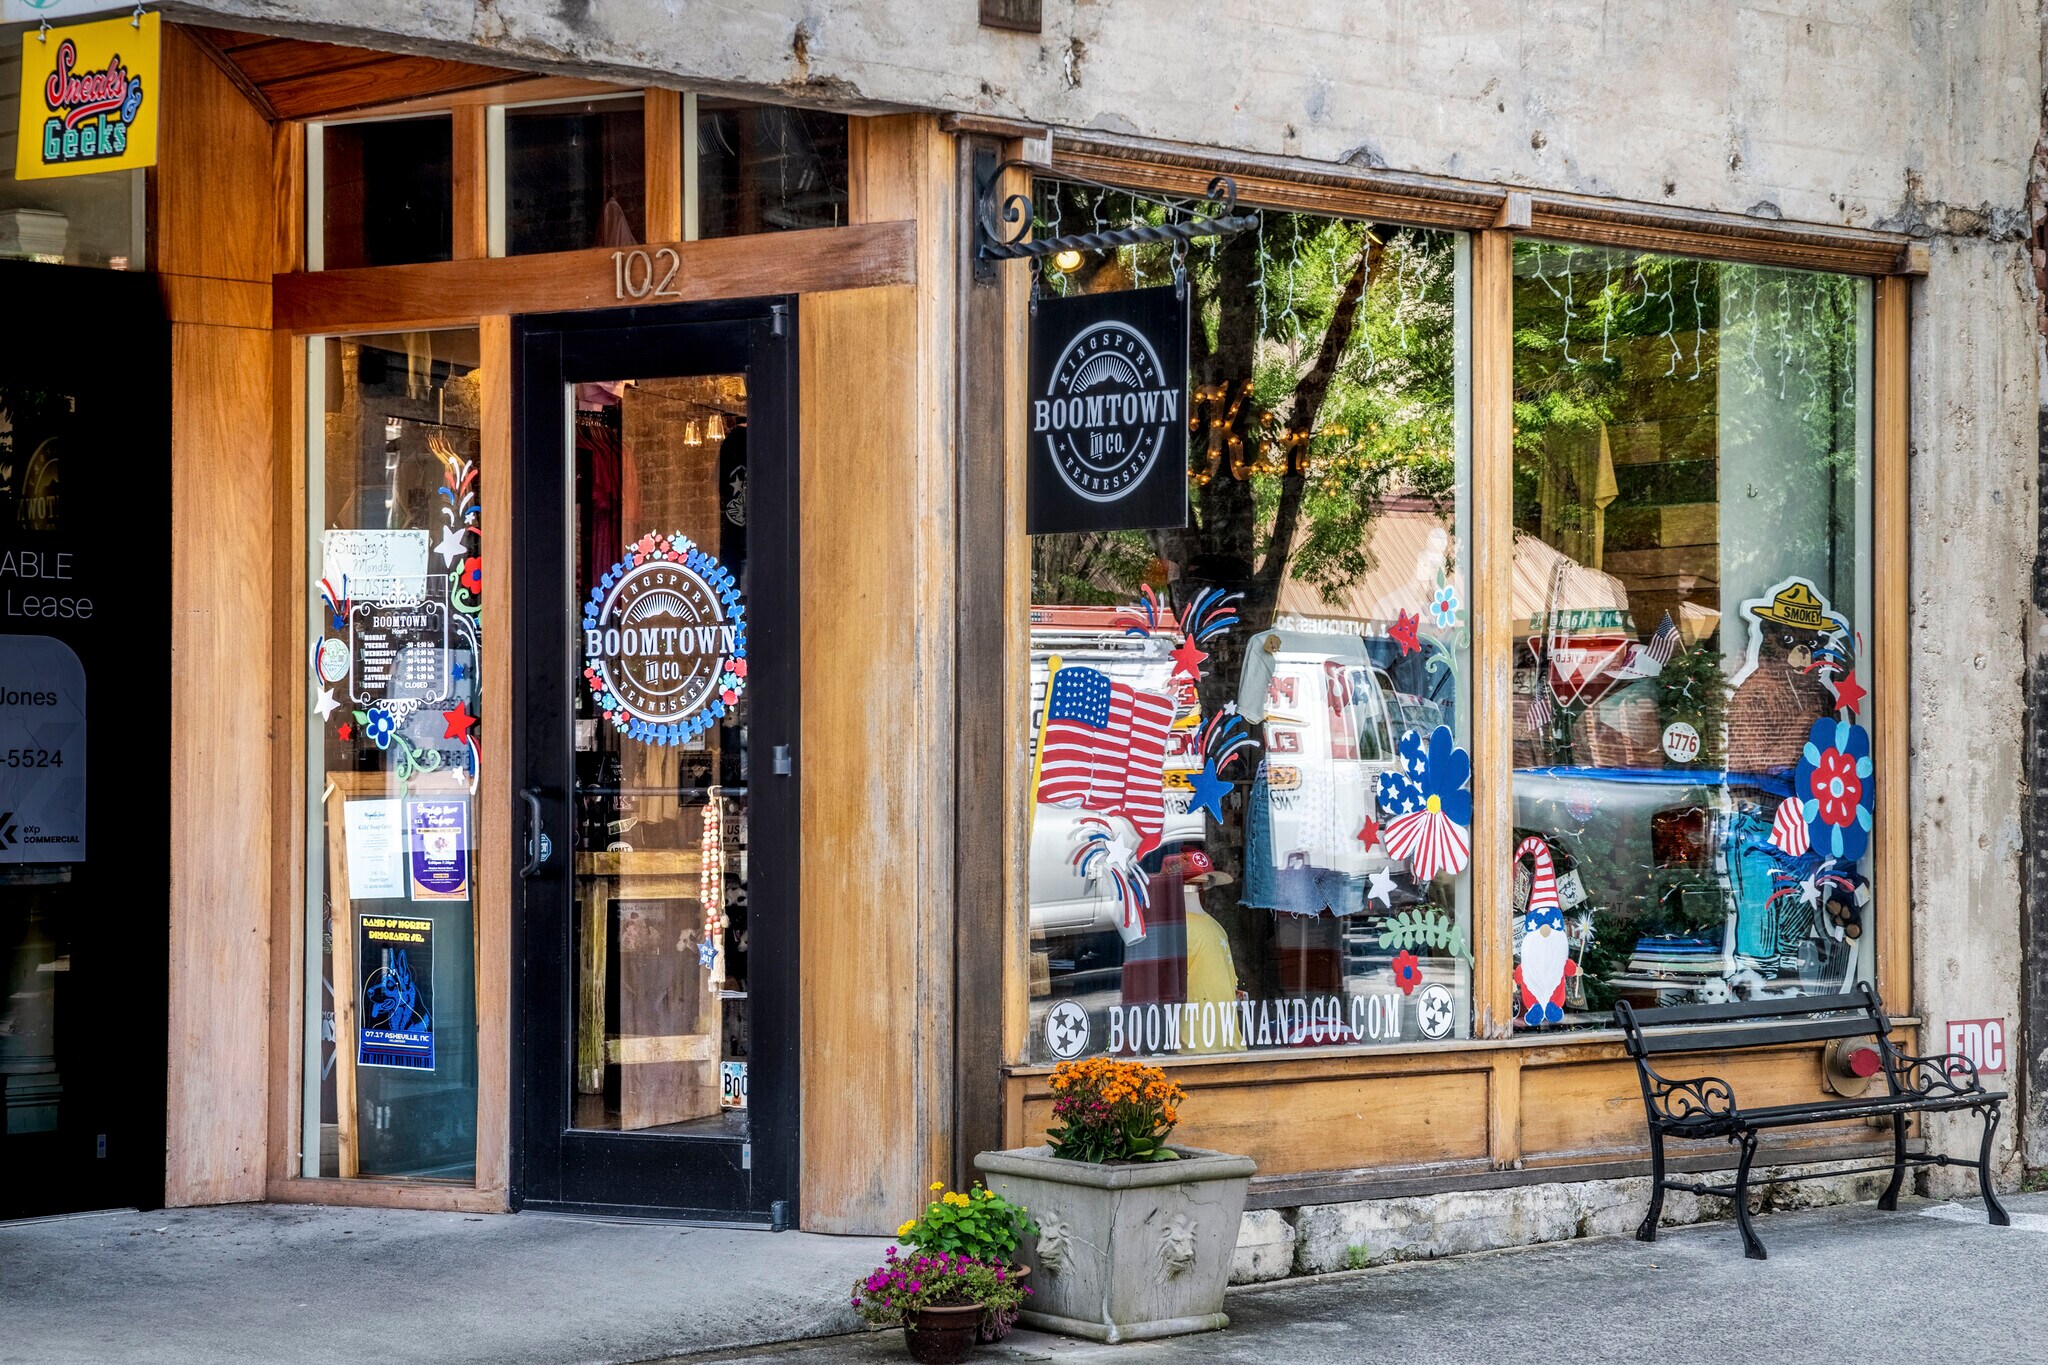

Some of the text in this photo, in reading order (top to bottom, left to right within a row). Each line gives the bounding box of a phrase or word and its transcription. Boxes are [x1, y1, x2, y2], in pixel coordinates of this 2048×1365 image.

[46, 40, 143, 123] Sneaks &
[44, 113, 126, 160] Geeks
[611, 247, 681, 299] 102
[1061, 333, 1153, 386] KINGSPORT
[1033, 389, 1179, 432] BOOMTOWN
[1105, 432, 1126, 454] CO.
[1066, 451, 1146, 490] TENNESSEE
[335, 537, 382, 561] Sunday
[353, 559, 394, 576] Monday
[7, 589, 93, 618] Lease
[612, 573, 711, 618] KINGSPORT
[373, 616, 427, 628] BOOMTOWN
[1783, 606, 1821, 622] SMOKEY
[583, 625, 737, 657] BOOMTOWN
[661, 661, 683, 680] CO.
[618, 679, 706, 713] TENNESSEE
[1668, 732, 1697, 752] 1776
[24, 825, 40, 834] eXp
[24, 835, 80, 844] COMMERCIAL
[362, 918, 431, 931] BAND OF HORSES
[368, 930, 411, 942] DINOSAUR
[1108, 993, 1401, 1053] BOOMTOWNANDCO.COM
[384, 1032, 420, 1042] ASHEVILLE,
[1949, 1021, 2002, 1071] FDC
